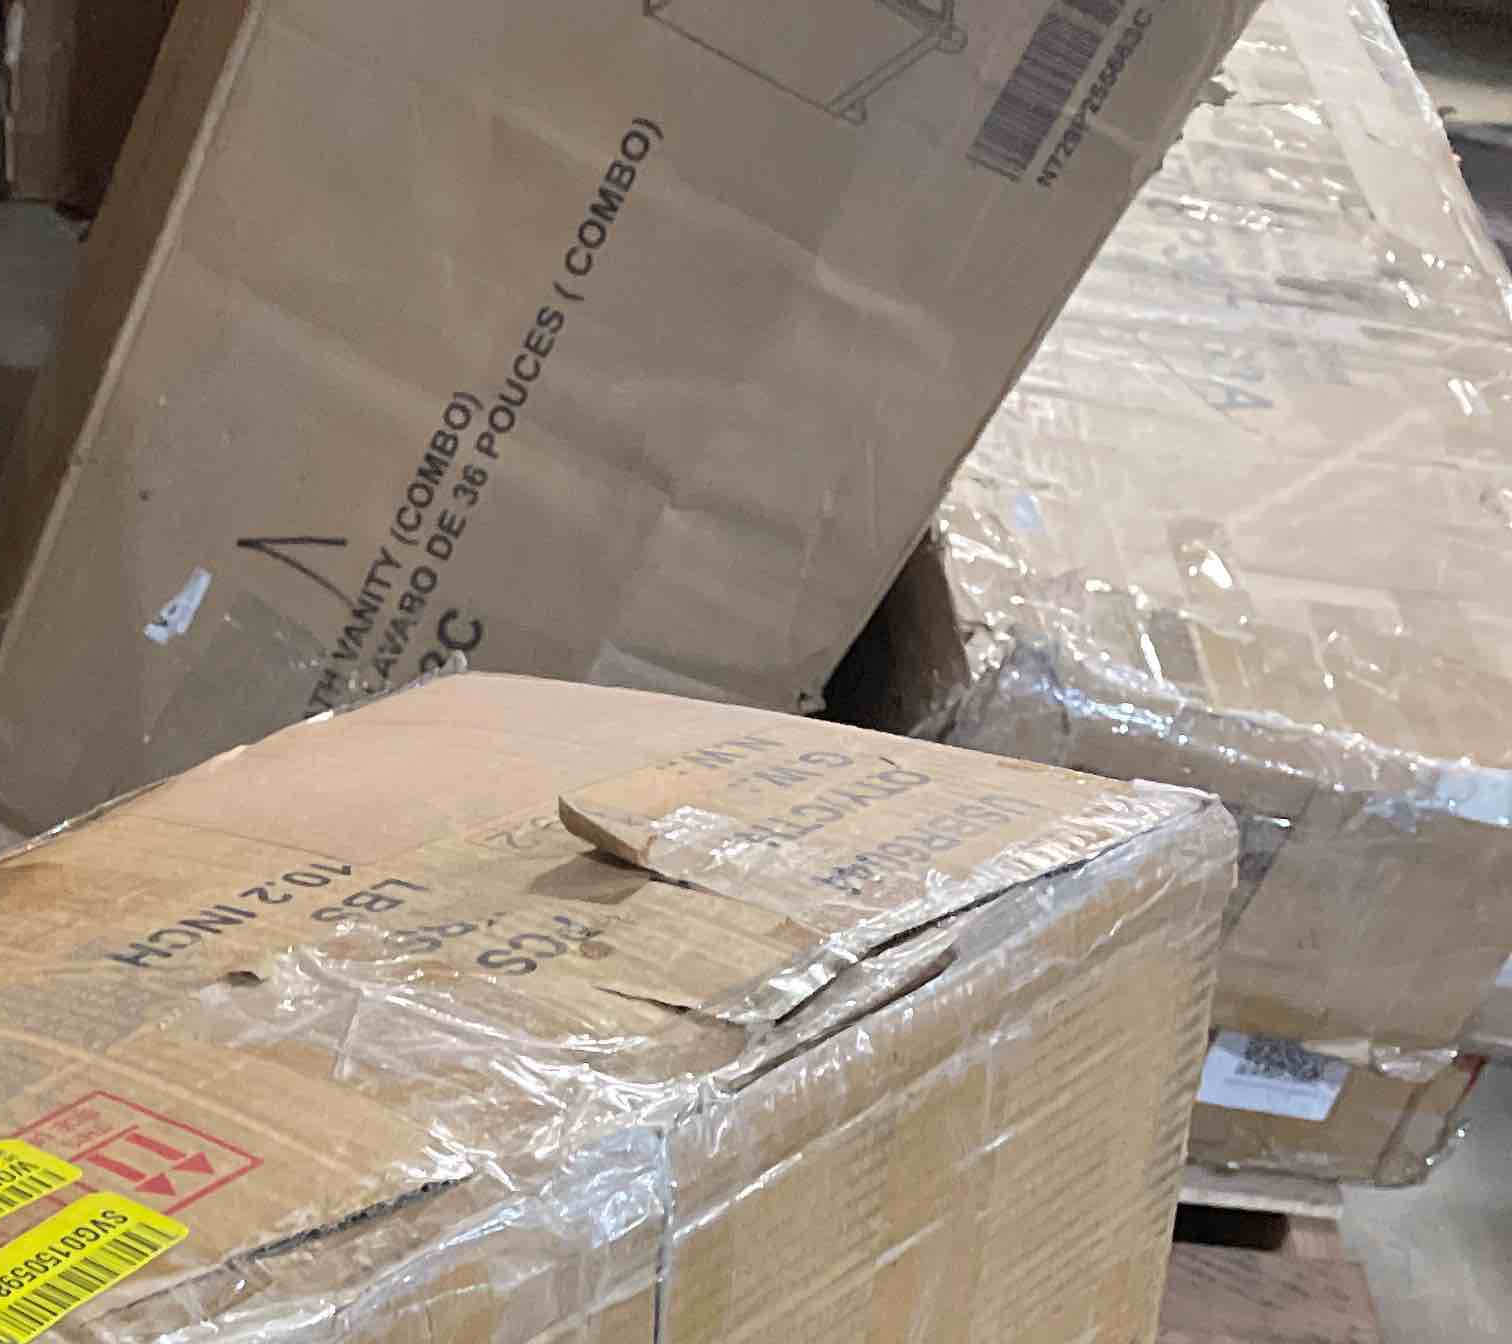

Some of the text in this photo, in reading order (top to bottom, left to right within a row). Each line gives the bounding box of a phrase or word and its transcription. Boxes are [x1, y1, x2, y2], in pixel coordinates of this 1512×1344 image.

[331, 546, 402, 659] VANITY
[390, 391, 485, 546] (COMBO)
[426, 509, 468, 562] DE
[452, 463, 489, 507] 36
[475, 305, 565, 460] POUCES
[102, 862, 352, 970] 10.2 INCH
